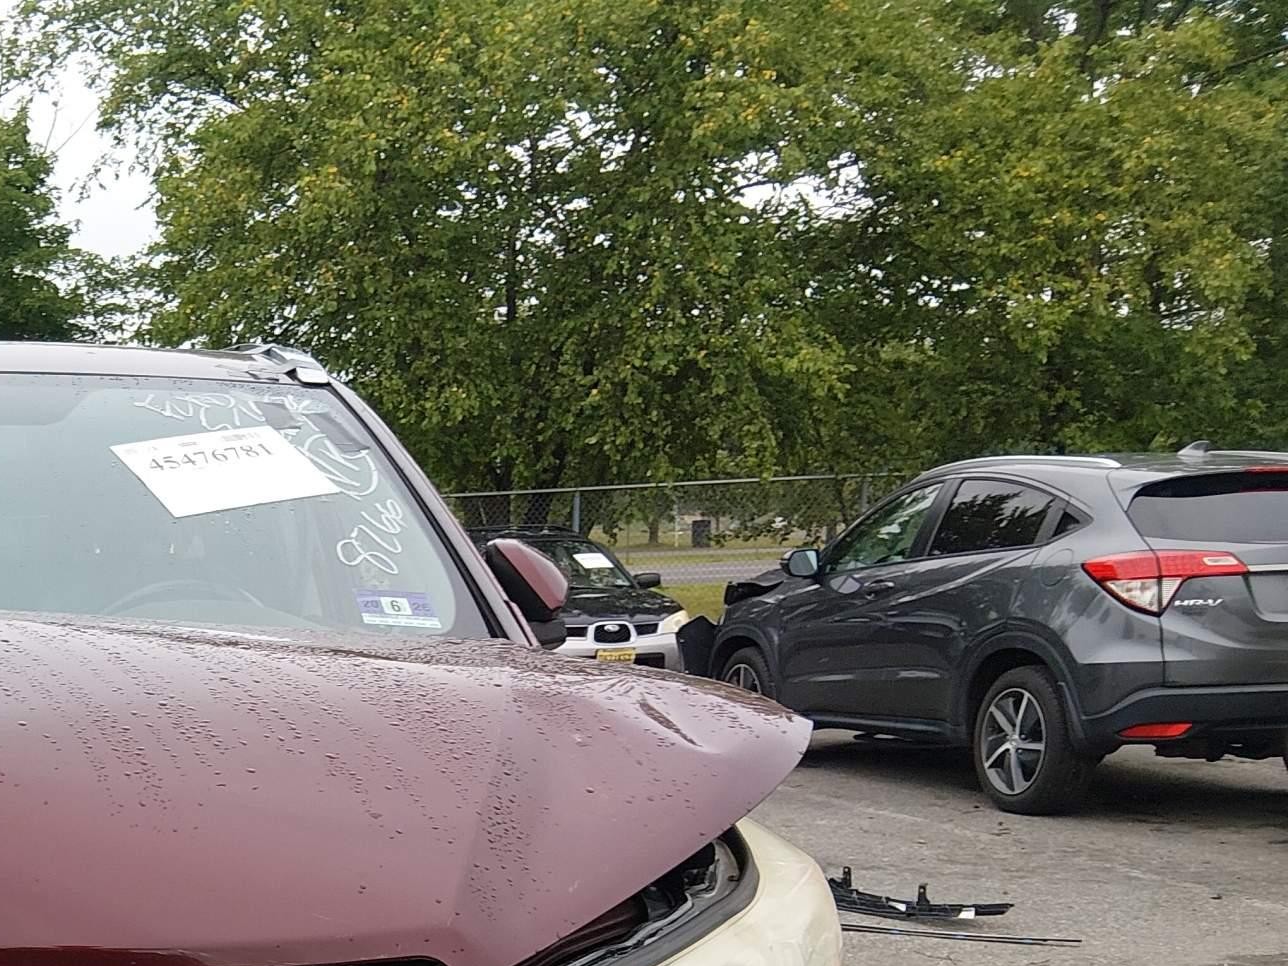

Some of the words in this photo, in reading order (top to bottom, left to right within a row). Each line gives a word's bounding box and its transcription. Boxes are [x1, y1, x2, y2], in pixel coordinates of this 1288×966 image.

[149, 443, 274, 471] 45476781
[390, 600, 401, 612] 6
[1174, 598, 1224, 607] HR-V
